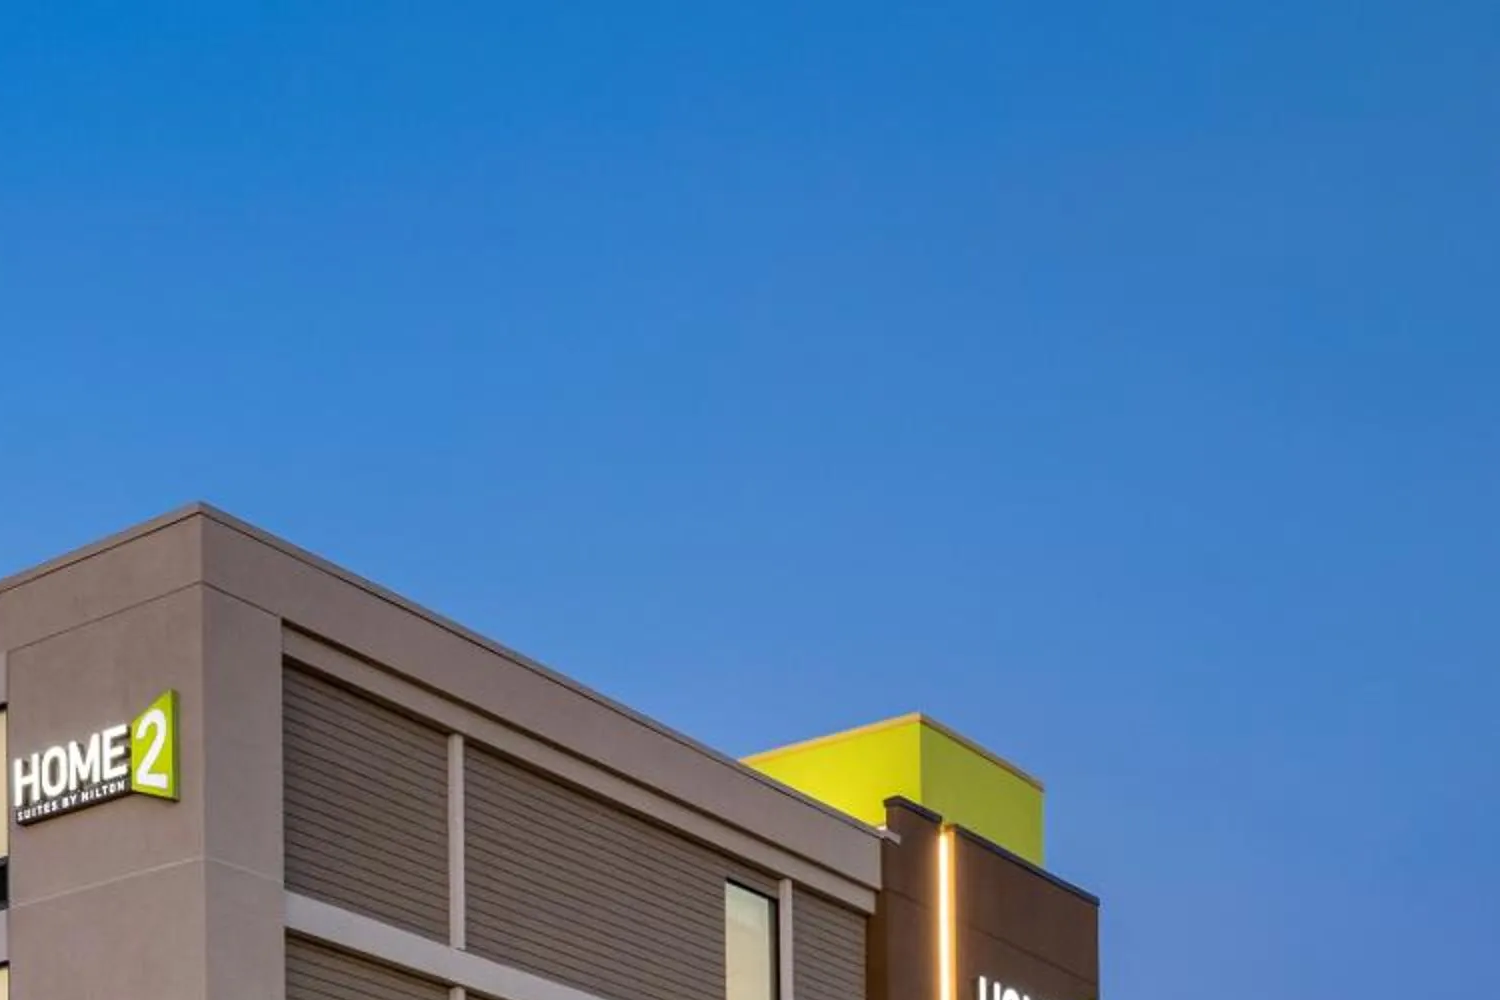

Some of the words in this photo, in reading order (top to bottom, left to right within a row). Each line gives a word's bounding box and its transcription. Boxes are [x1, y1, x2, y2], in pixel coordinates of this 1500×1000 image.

[17, 799, 57, 822] SUITES
[63, 795, 77, 809] BY
[81, 780, 126, 802] HILTON
